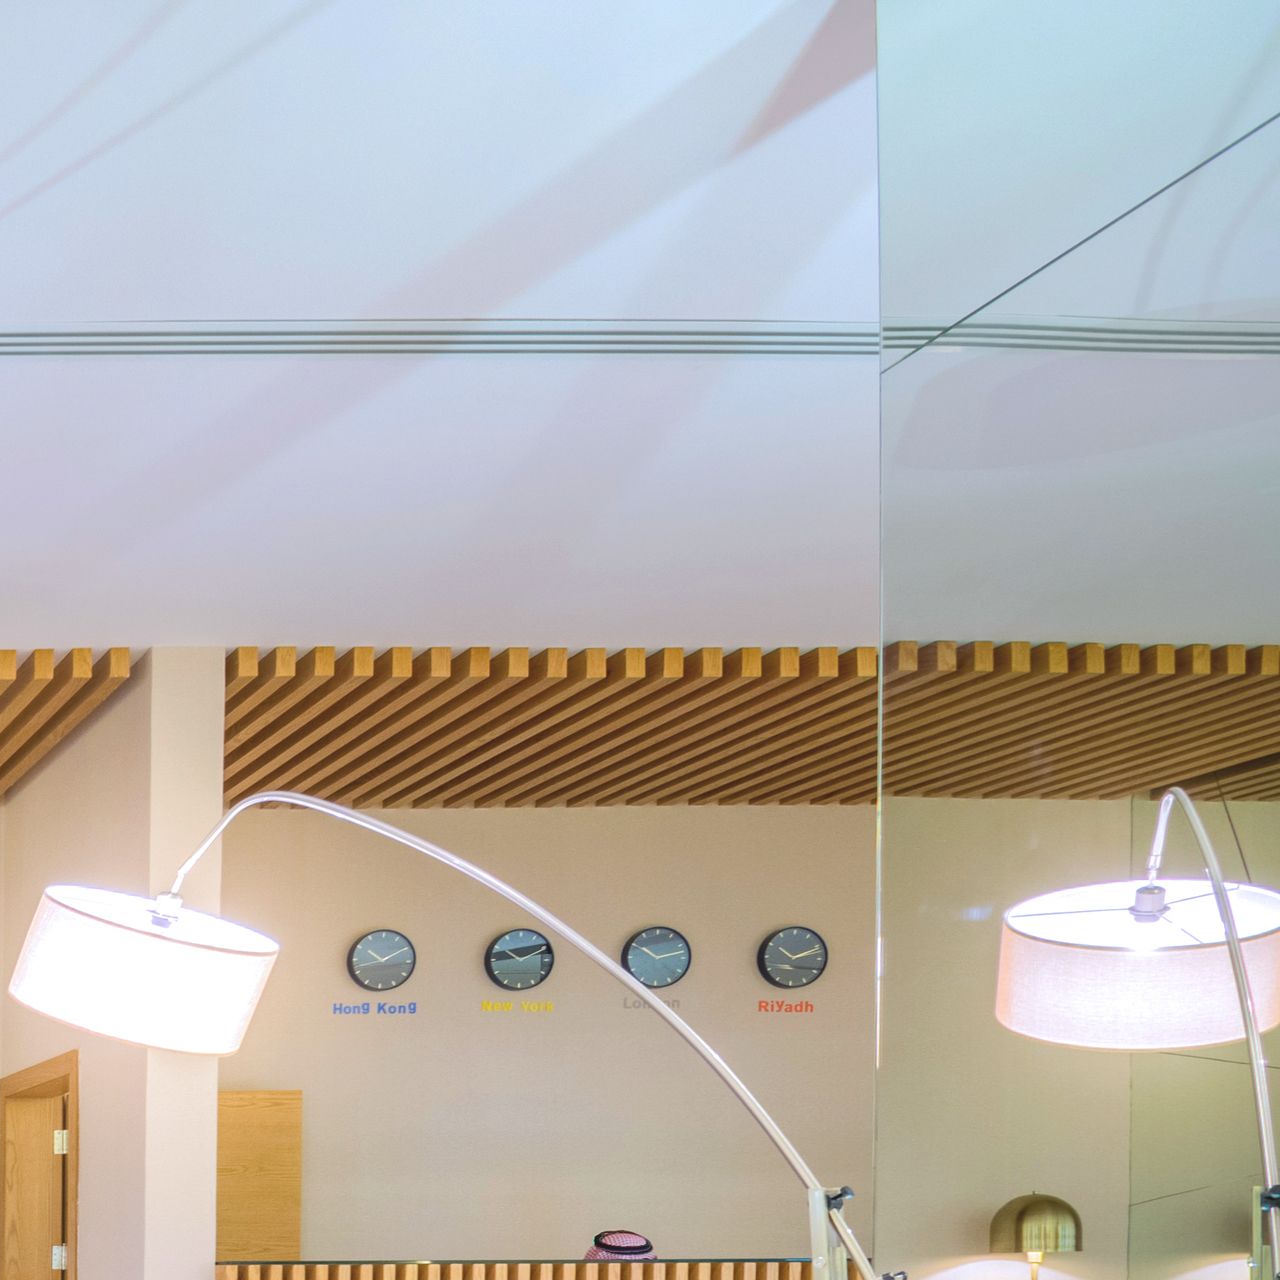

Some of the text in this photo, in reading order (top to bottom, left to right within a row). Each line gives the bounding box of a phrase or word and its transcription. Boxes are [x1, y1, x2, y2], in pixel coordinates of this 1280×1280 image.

[332, 1002, 417, 1014] Hong Kong
[481, 1001, 554, 1013] New York
